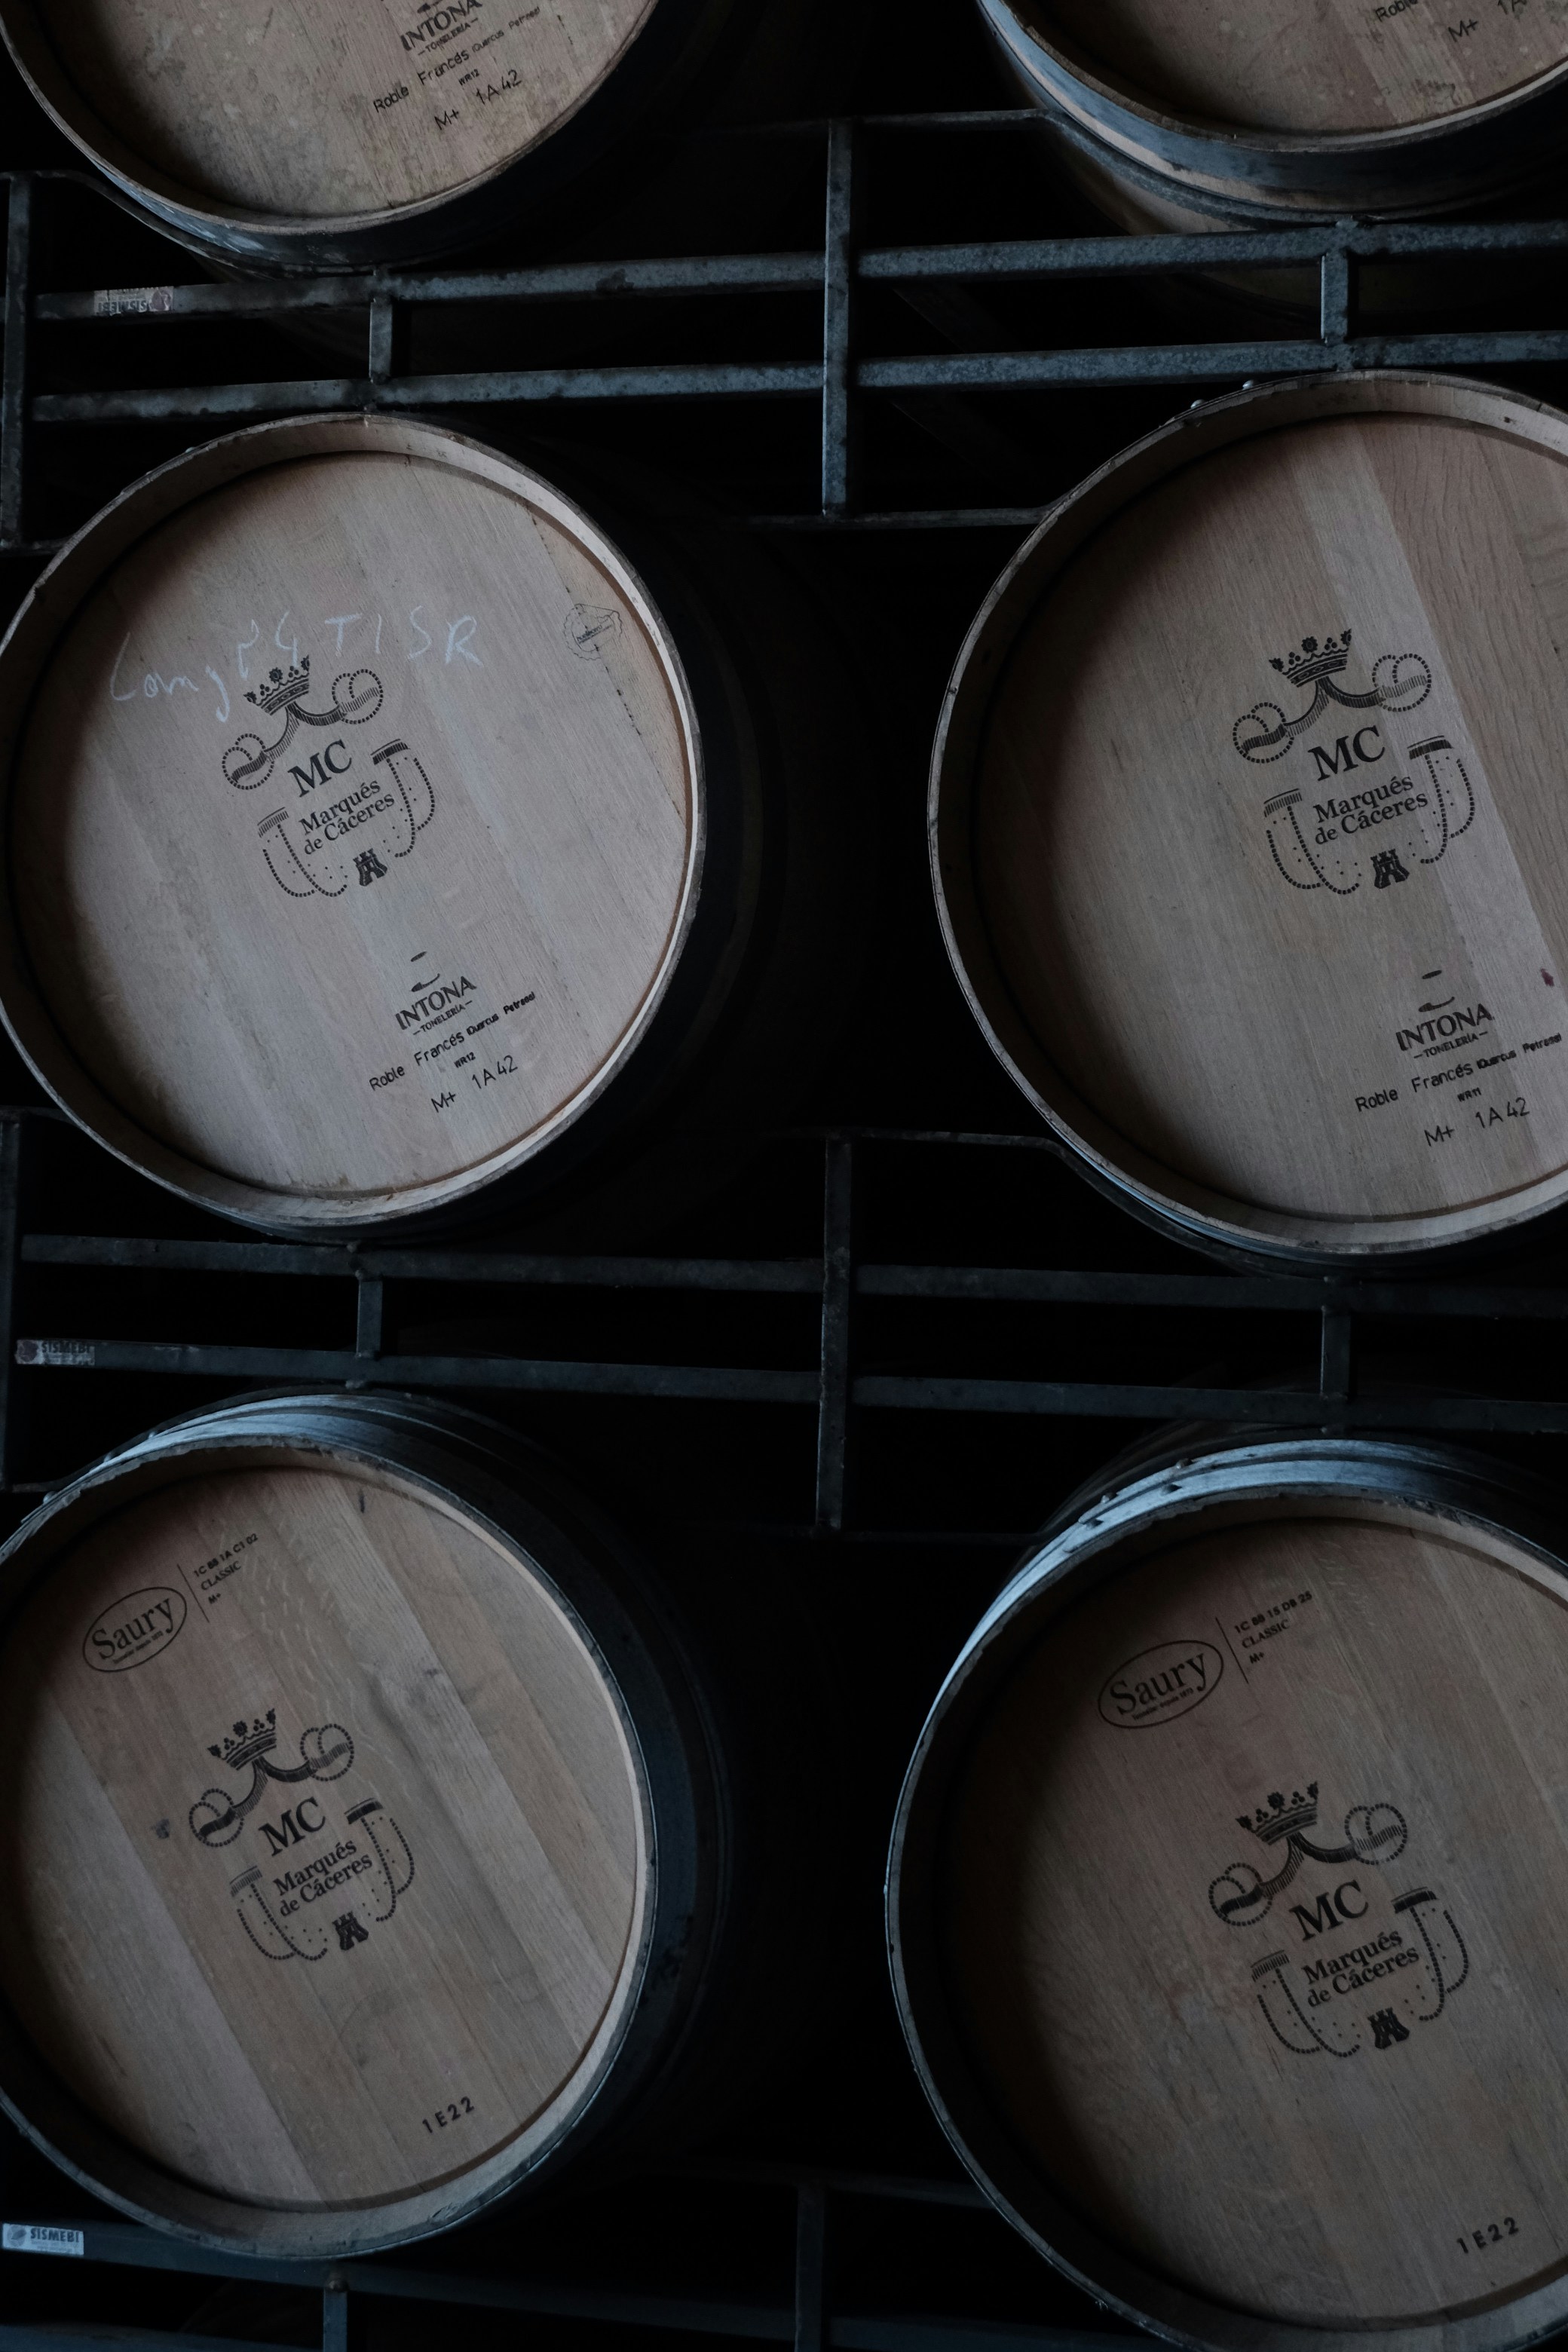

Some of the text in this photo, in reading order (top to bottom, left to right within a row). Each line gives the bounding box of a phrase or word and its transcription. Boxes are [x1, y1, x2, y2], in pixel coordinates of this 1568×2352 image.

[400, 0, 482, 51] INTONA
[1448, 19, 1478, 42] M+
[373, 86, 409, 112] Roble
[417, 50, 470, 85] Francés
[434, 109, 459, 130] M+
[287, 740, 352, 798] MC
[1308, 725, 1386, 782] MC
[299, 780, 381, 835] Marqués
[304, 794, 395, 855] de Cáceres
[1313, 776, 1413, 823] Marqués
[1315, 792, 1429, 845] de Cáceres
[395, 975, 476, 1030] INTONA
[421, 1003, 466, 1033] TONELERÍA
[1395, 1003, 1494, 1051] INTONA
[369, 1065, 406, 1091] Roble
[414, 1031, 465, 1066] Francés
[454, 1052, 476, 1068] WR12
[1424, 1034, 1479, 1058] TONELERÍA
[431, 1092, 456, 1113] M+
[1355, 1089, 1398, 1112] Roble
[1411, 1063, 1474, 1092] Francés
[1424, 1125, 1454, 1147] M+
[201, 1560, 241, 1590] CLASSIC
[91, 1598, 174, 1660] Saury
[1242, 1619, 1290, 1648] CLASSIC
[1110, 1653, 1206, 1715] Saury
[258, 1796, 326, 1857] MC
[273, 1839, 357, 1896] Marqués
[280, 1854, 372, 1917] de Cáceres
[1288, 1879, 1369, 1941] MC
[1301, 1930, 1403, 1985] Marqués
[1306, 1947, 1419, 2007] de Cáceres
[31, 2228, 79, 2243] SISMEBI
